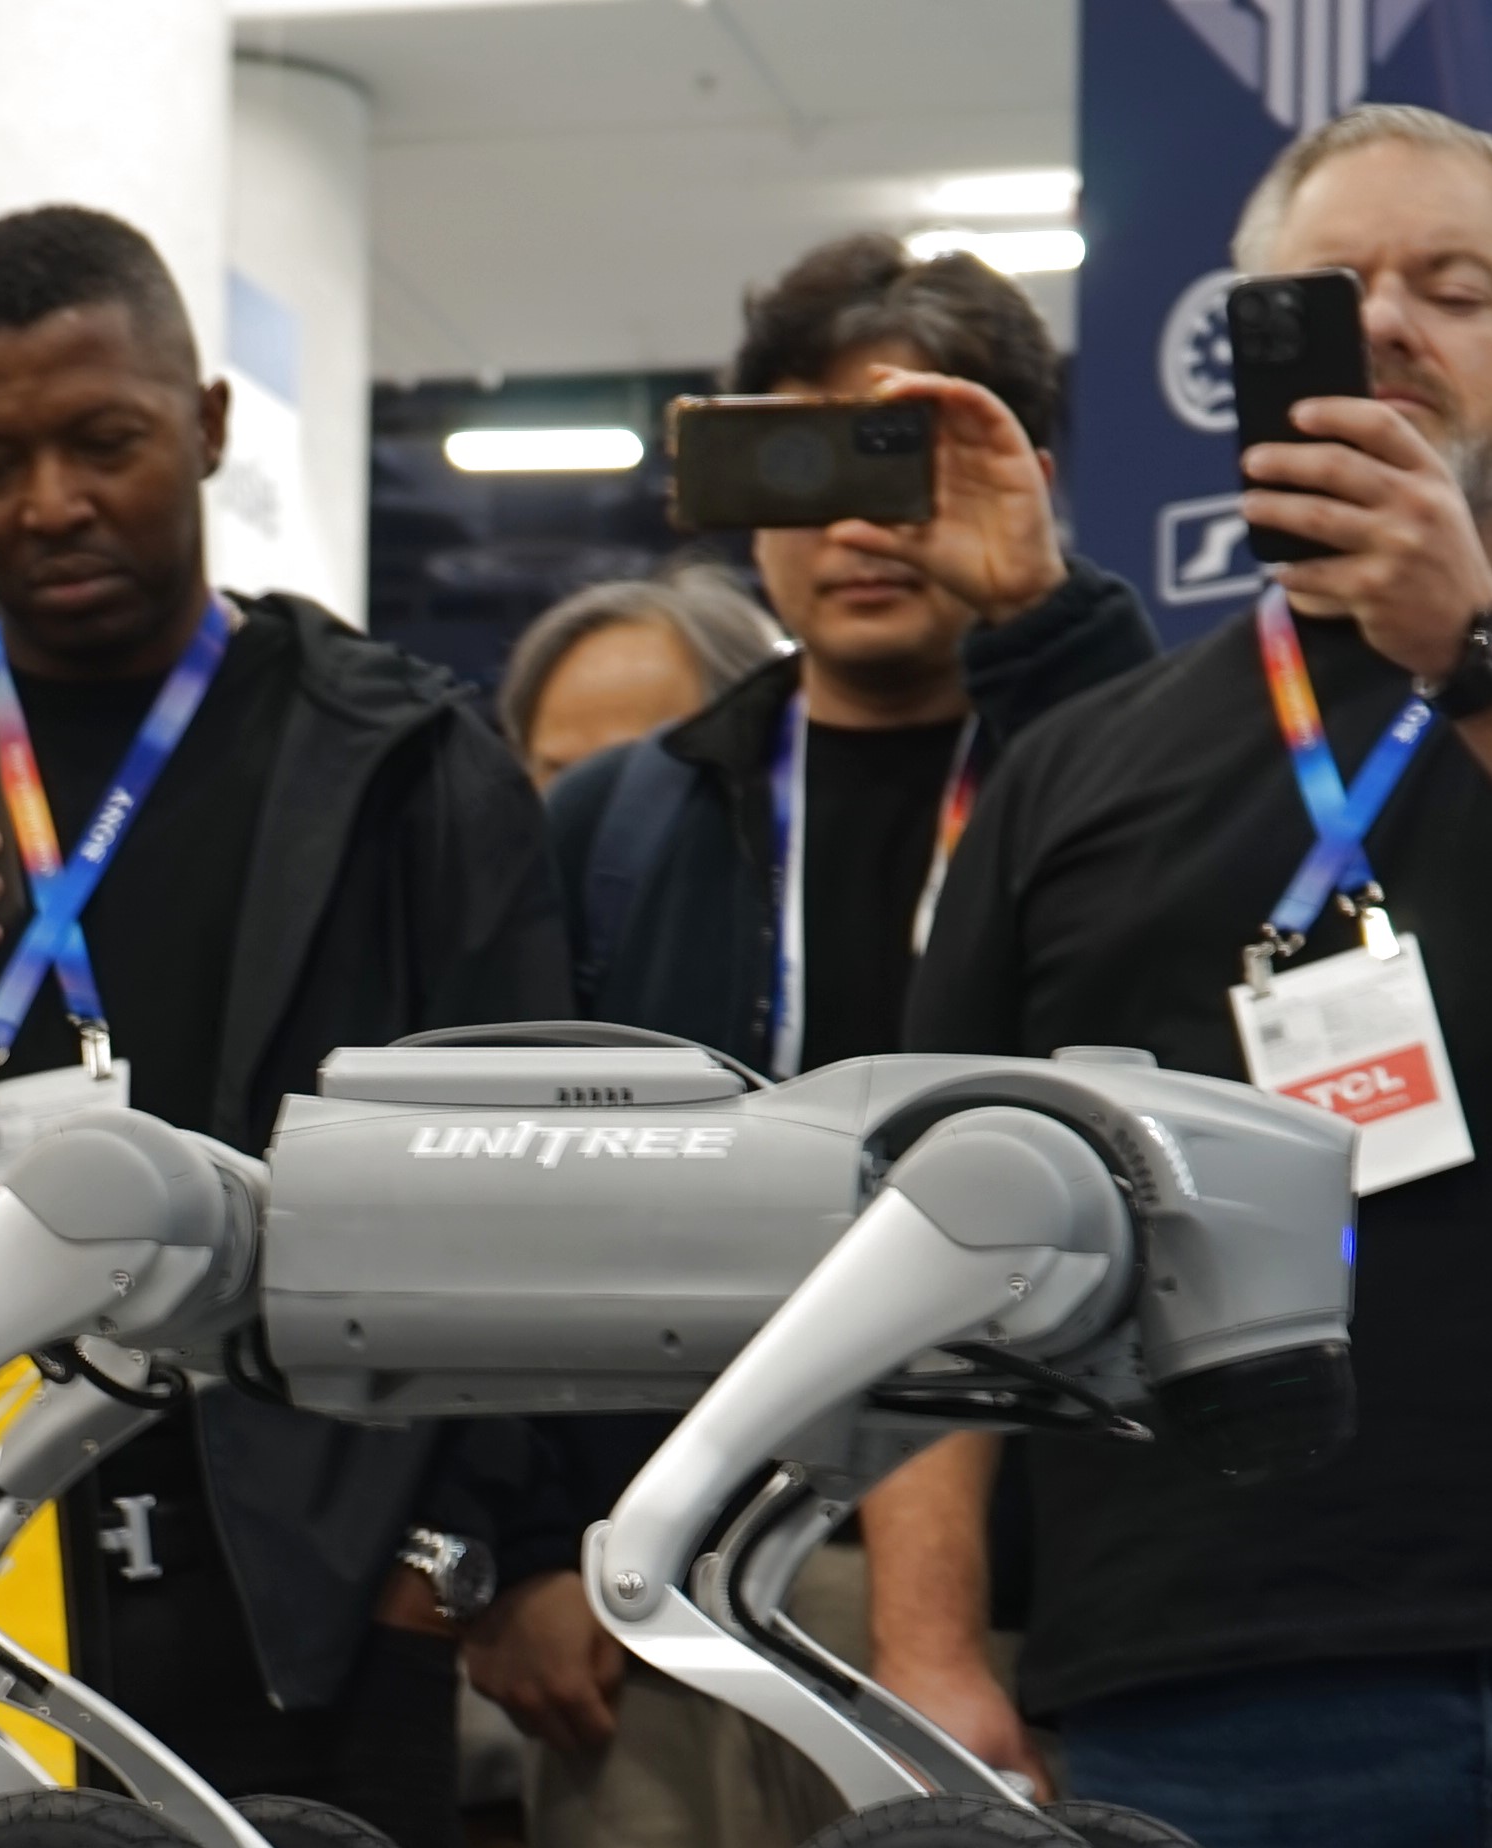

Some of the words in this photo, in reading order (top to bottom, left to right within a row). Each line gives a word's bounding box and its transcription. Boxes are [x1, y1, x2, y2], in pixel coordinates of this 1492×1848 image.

[79, 786, 135, 864] SONY
[1301, 1063, 1408, 1112] TCL
[410, 1120, 738, 1169] UNITREE
